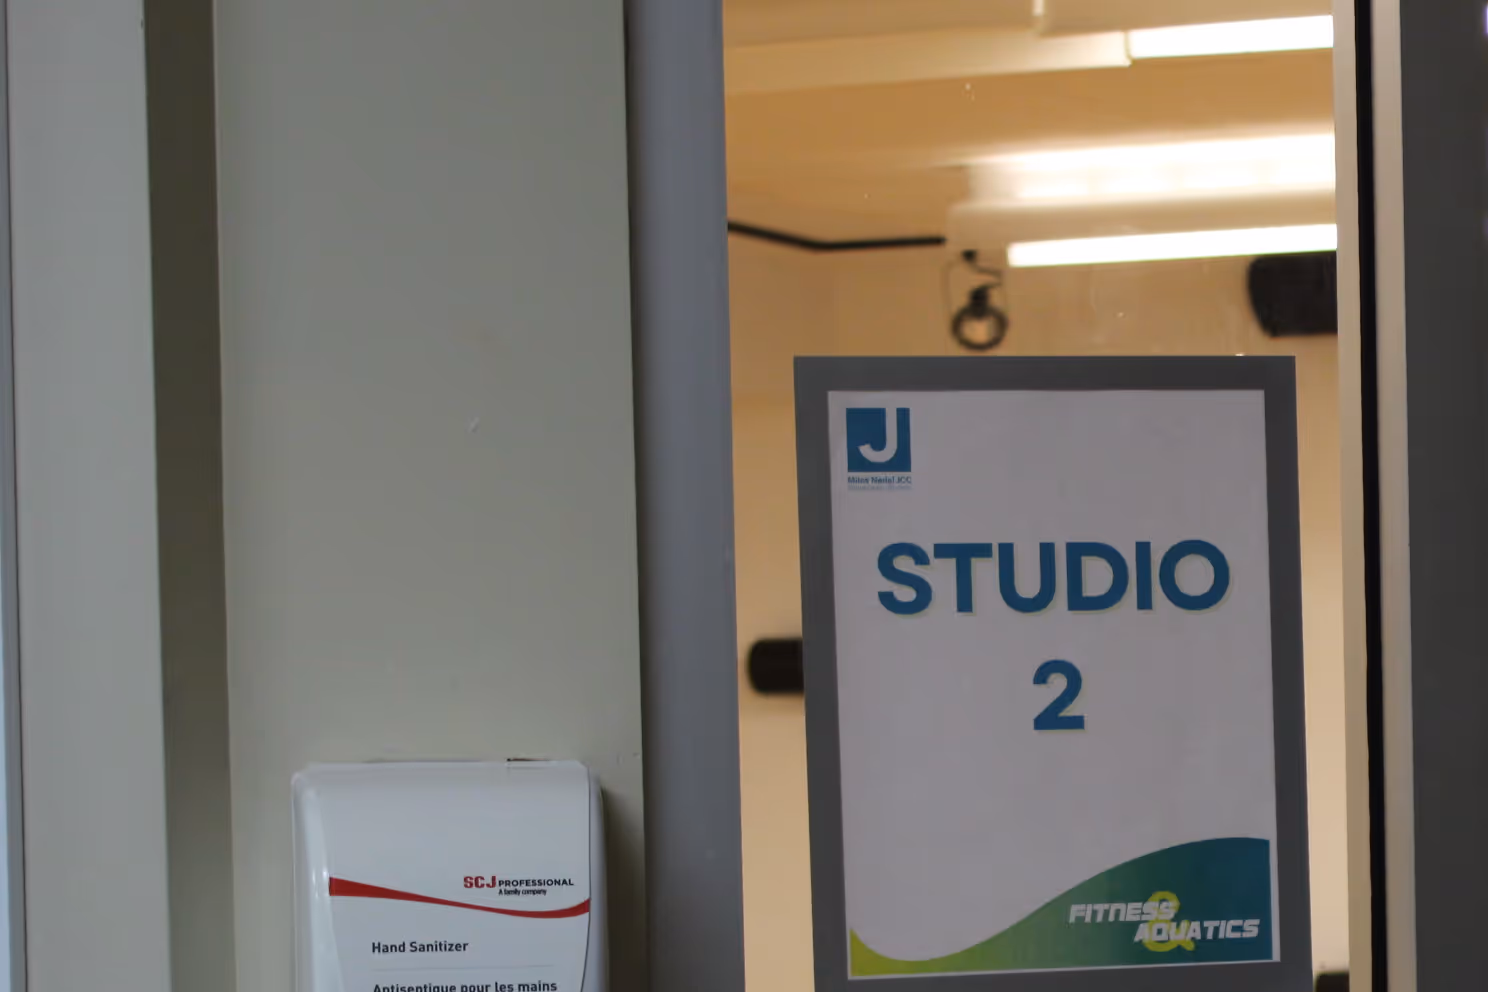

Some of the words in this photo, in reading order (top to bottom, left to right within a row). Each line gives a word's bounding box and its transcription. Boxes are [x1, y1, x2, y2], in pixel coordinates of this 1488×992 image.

[858, 408, 898, 462] J
[877, 539, 1230, 615] STUDIO
[1032, 659, 1087, 731] 2
[463, 875, 497, 889] SCJ
[498, 878, 575, 888] PROFESSIONAL
[521, 888, 547, 896] company
[1069, 901, 1176, 924] FITNESS
[1133, 918, 1261, 943] AQUATICS
[371, 941, 406, 954] Hand
[409, 940, 469, 953] Sanitizer
[494, 981, 514, 992] les
[517, 980, 558, 992] mains
